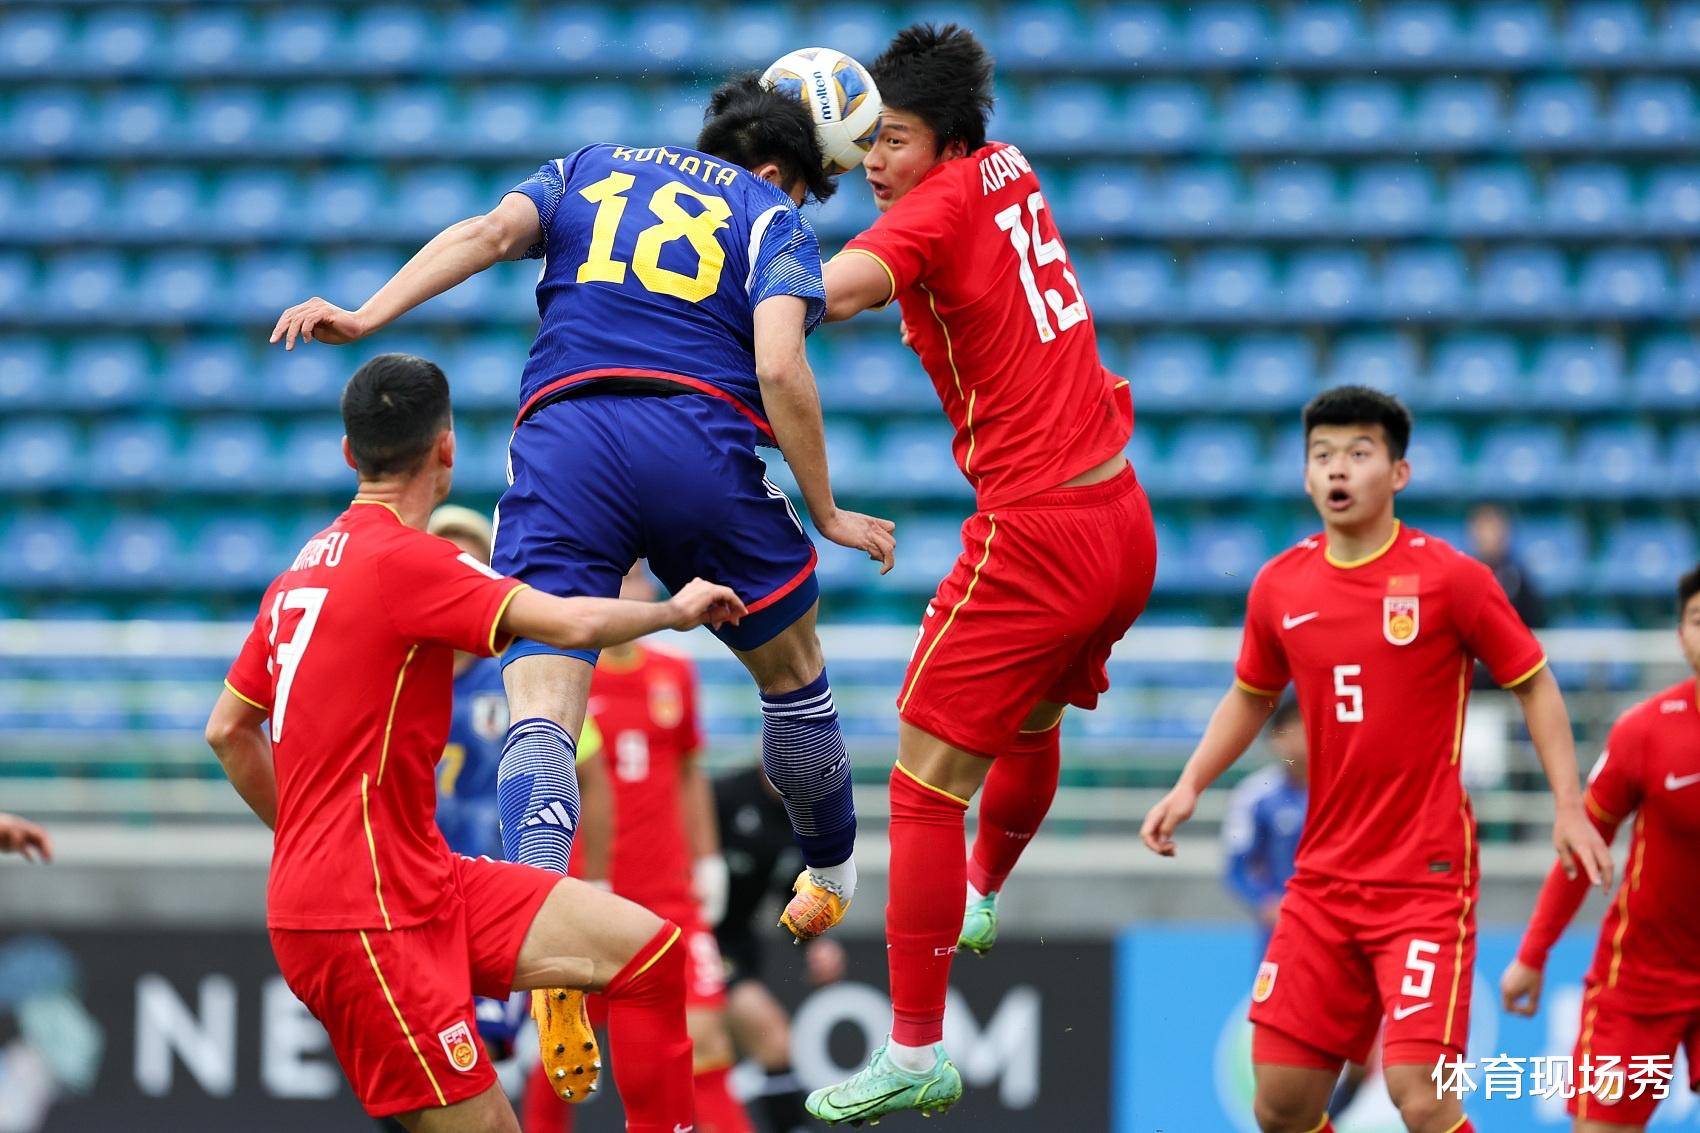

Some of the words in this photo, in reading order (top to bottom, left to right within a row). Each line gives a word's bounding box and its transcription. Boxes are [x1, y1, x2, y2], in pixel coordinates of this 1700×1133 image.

[813, 71, 832, 120] molten
[575, 170, 733, 304] 18
[994, 191, 1088, 344] 15
[1333, 664, 1364, 723] 5
[1401, 939, 1440, 999] 5
